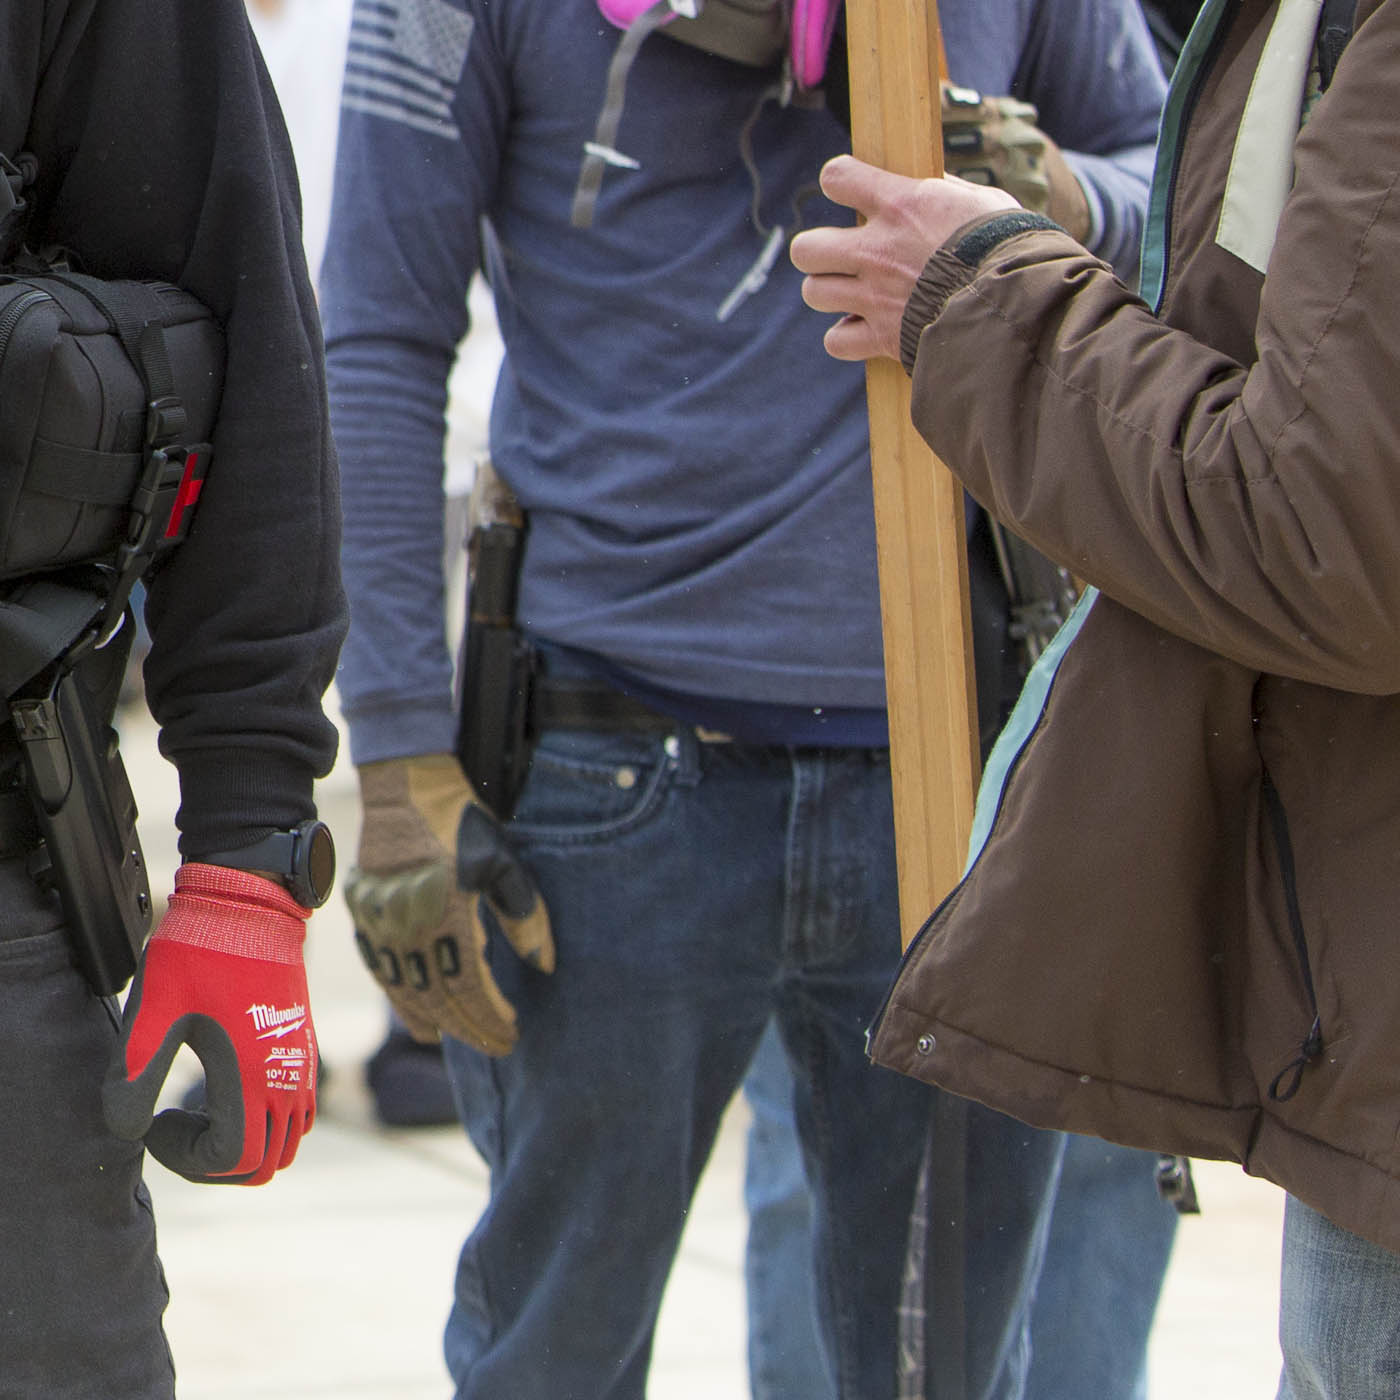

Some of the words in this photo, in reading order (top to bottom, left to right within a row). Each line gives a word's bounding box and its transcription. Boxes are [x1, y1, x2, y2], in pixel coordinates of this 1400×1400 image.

[246, 1003, 305, 1031] Milwaukee
[272, 1047, 286, 1056] CUT
[288, 1070, 301, 1082] XL
